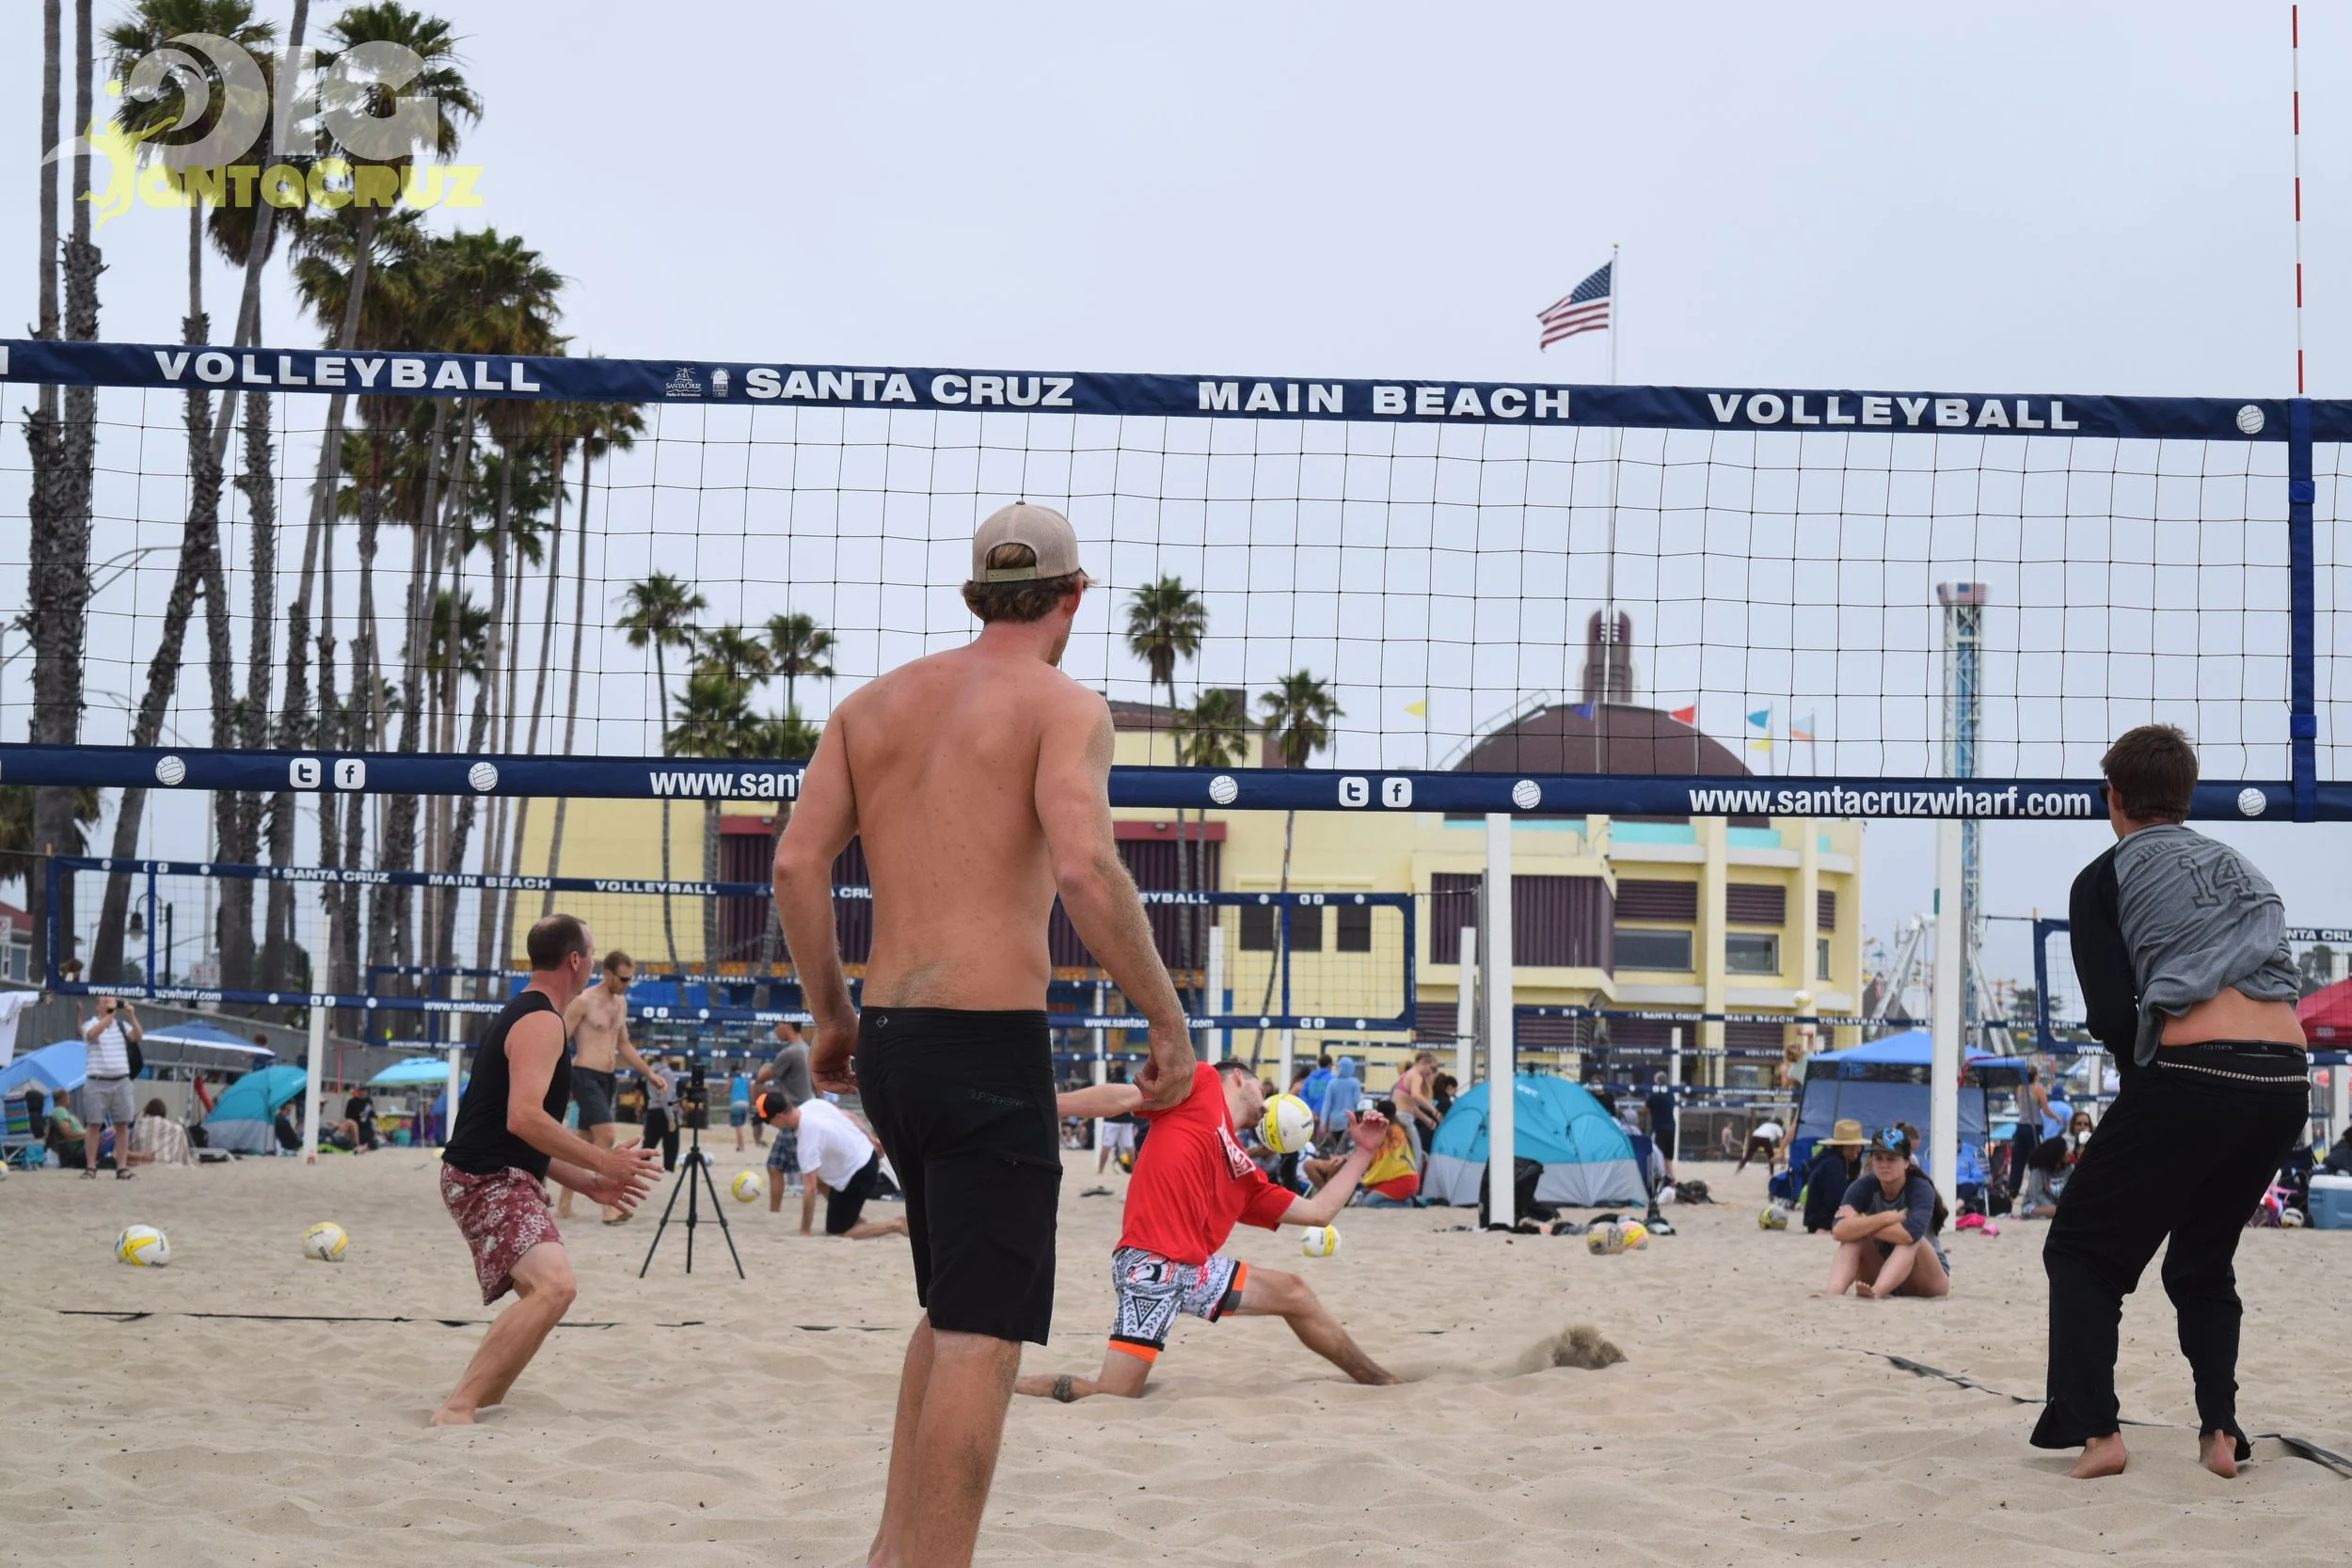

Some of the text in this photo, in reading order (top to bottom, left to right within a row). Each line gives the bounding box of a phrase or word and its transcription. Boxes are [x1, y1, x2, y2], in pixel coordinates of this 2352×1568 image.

[153, 351, 540, 391] VOLLEYBALL
[745, 368, 916, 403] SANTA
[930, 374, 1074, 406] CRUZ
[1198, 381, 1570, 419] MAIN BEACH
[1708, 393, 2079, 430] VOLLEYBALL
[1689, 784, 2092, 817] www.santacruzwharf.com
[283, 868, 390, 884] SANTA CRUZ
[428, 874, 551, 891] MAIN BEACH
[595, 879, 717, 895] VOLLEYBALL
[2178, 852, 2256, 909] 14
[839, 887, 873, 899] CRU
[1138, 893, 1210, 905] EYBALL
[2321, 930, 2352, 942] CRU
